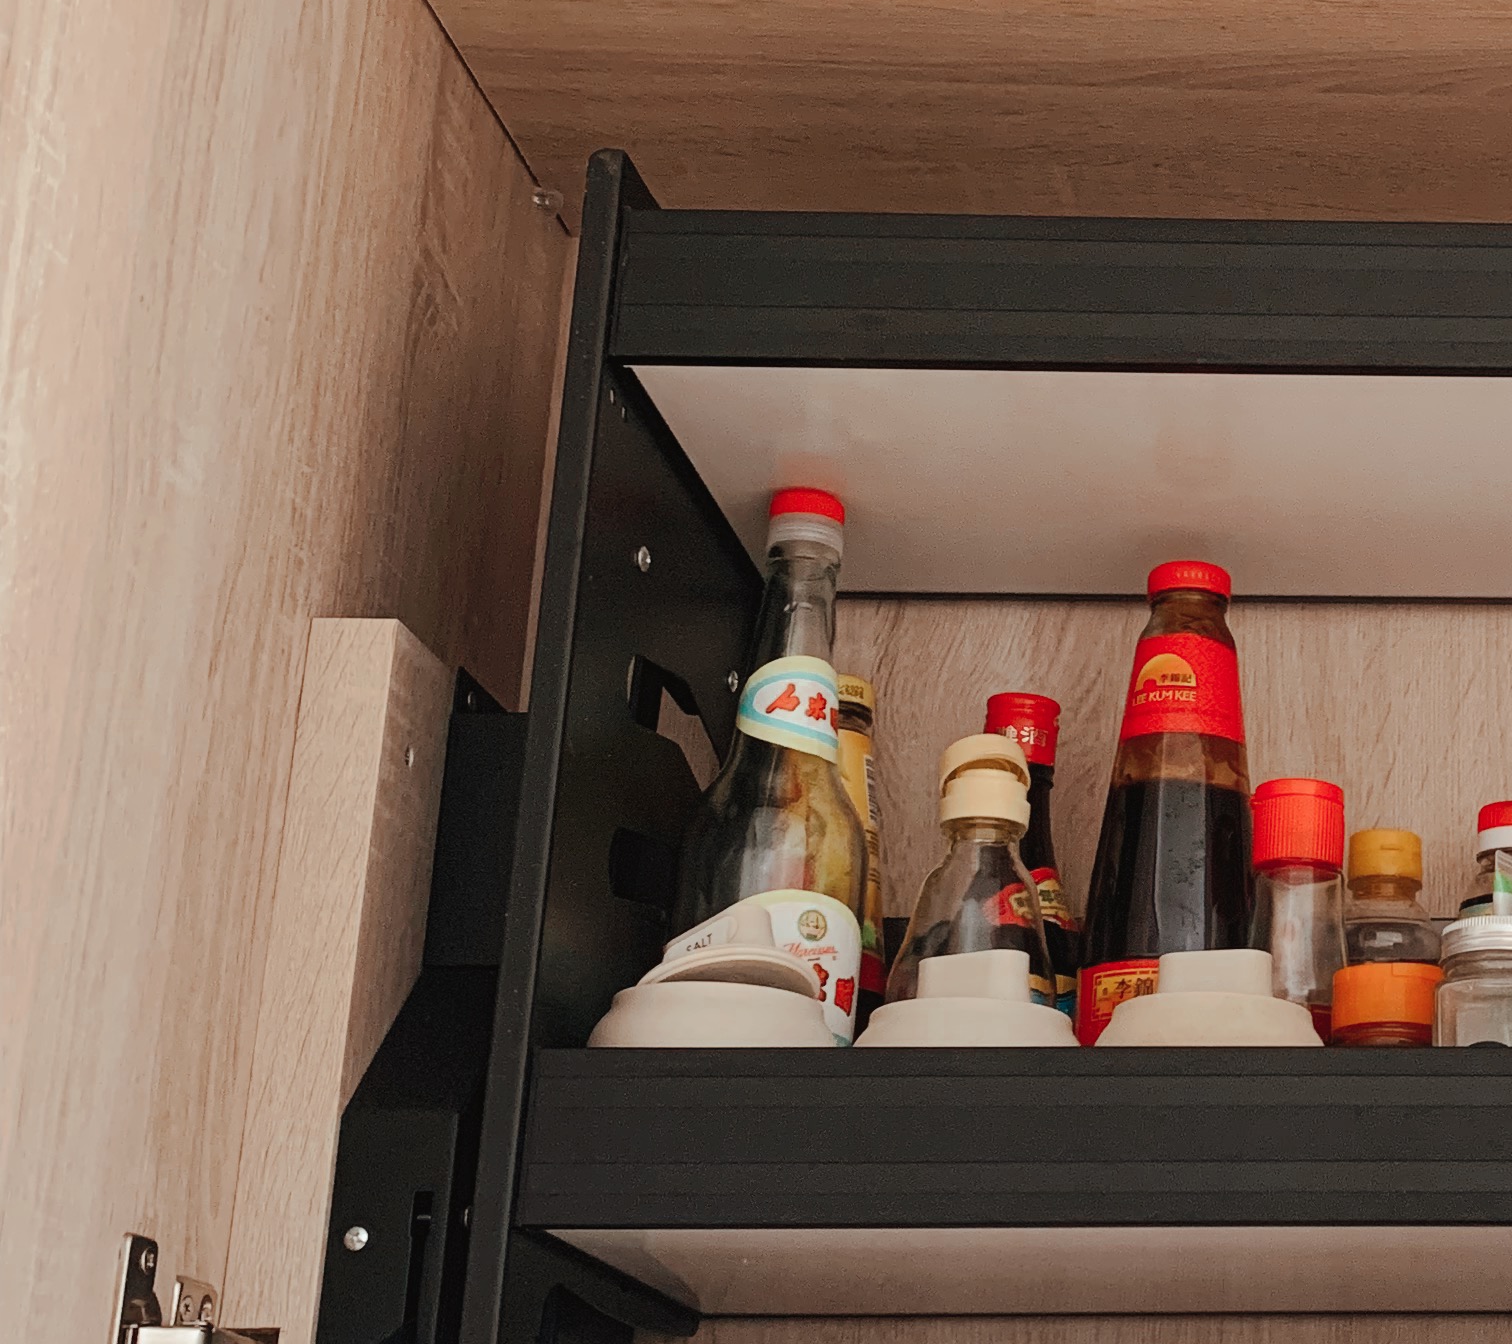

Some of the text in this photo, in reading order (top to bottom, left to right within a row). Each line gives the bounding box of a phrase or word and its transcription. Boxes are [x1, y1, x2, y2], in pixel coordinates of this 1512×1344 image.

[1132, 690, 1197, 707] LEE KUM KEE
